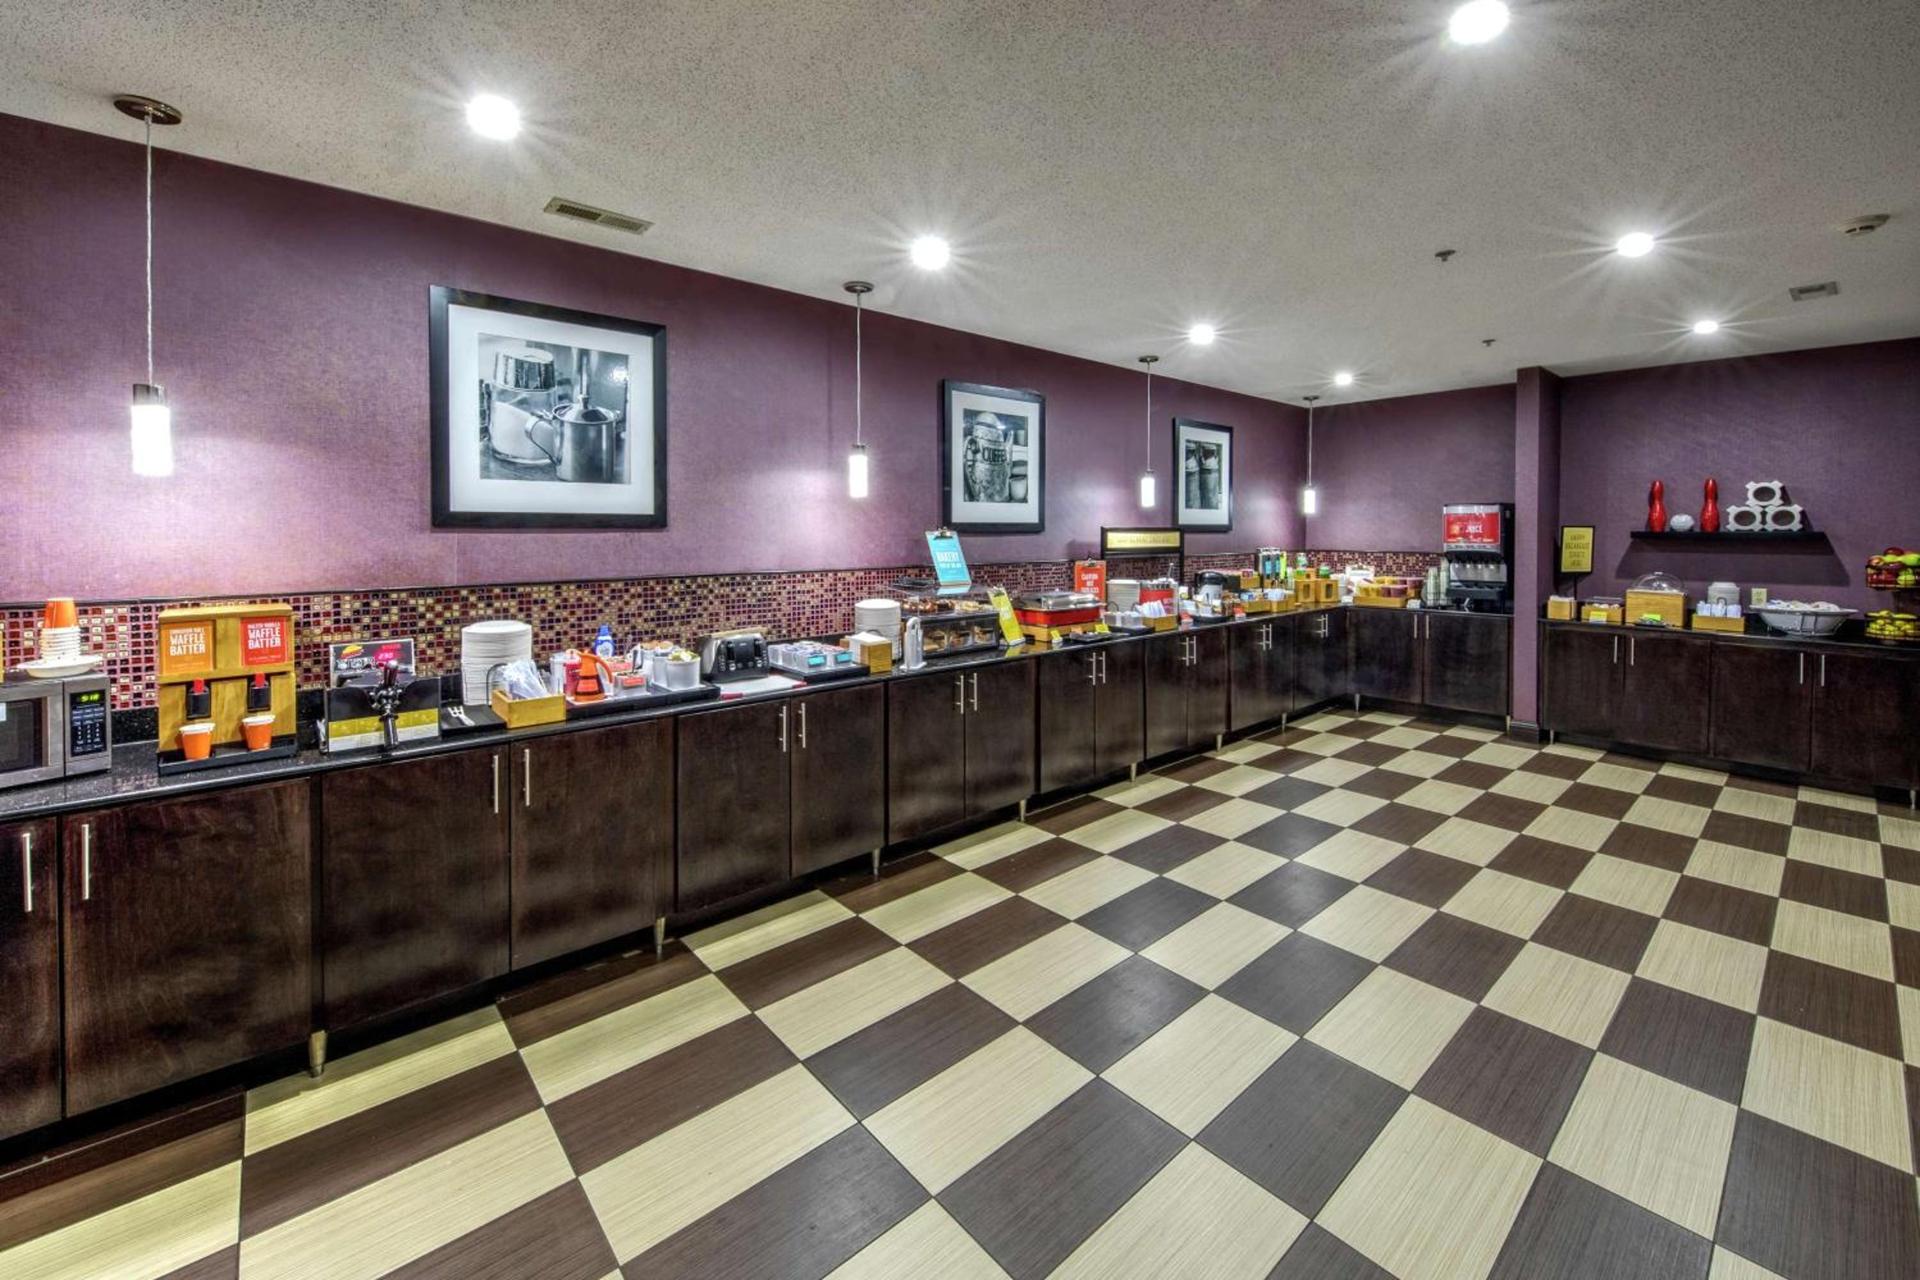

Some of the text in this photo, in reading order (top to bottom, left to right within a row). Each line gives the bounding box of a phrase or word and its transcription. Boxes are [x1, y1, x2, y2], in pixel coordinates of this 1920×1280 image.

[170, 632, 205, 645] WAFFLE
[248, 627, 281, 640] WAFFLE
[170, 642, 206, 656] BATTER
[248, 638, 281, 649] BATTER
